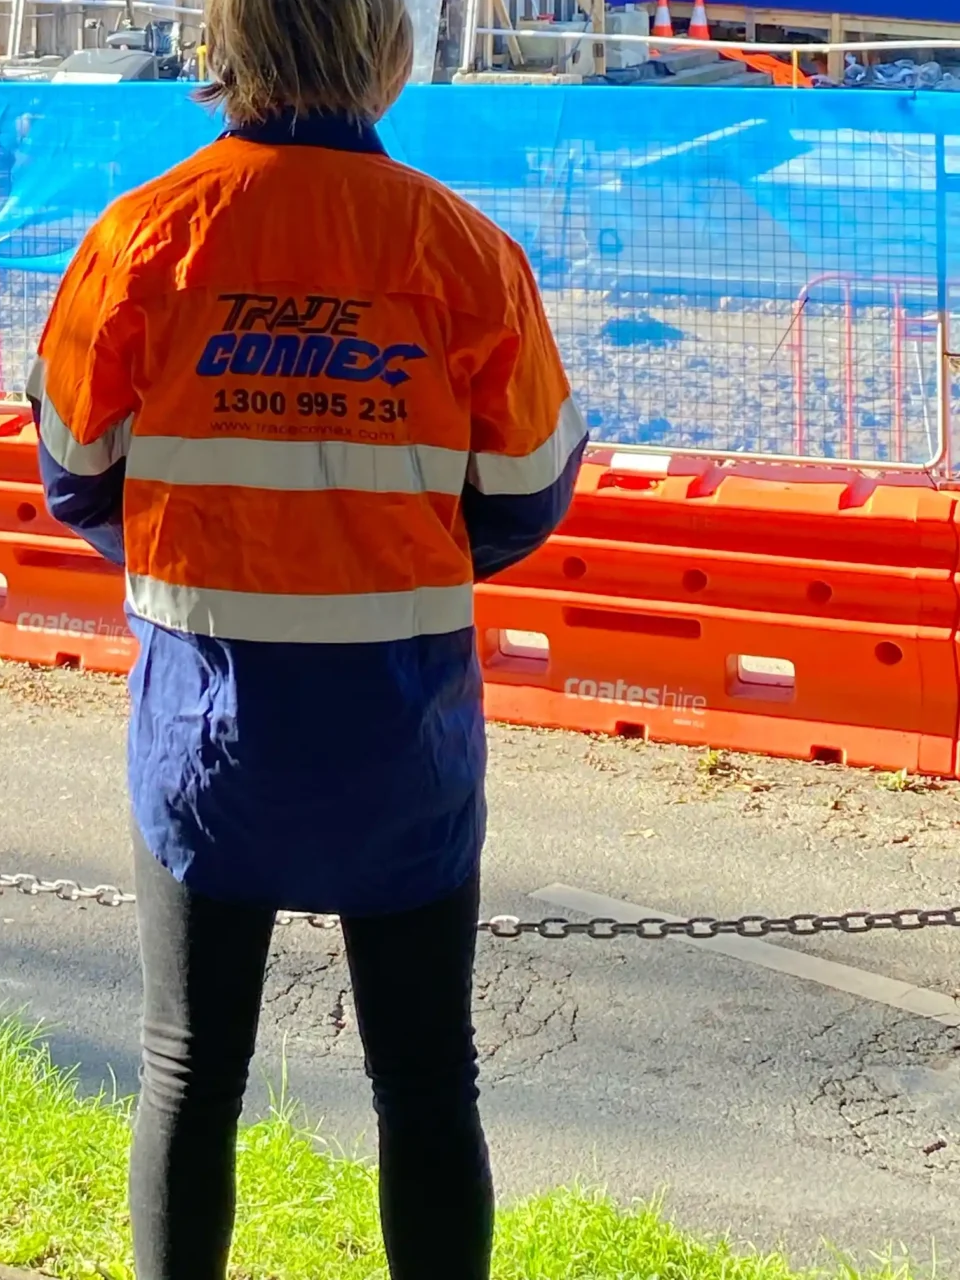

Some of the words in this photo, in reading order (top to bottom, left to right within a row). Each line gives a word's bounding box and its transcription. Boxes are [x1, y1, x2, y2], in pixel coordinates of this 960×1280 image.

[217, 293, 373, 337] TRADE
[213, 388, 287, 416] 1300
[296, 391, 349, 418] 995
